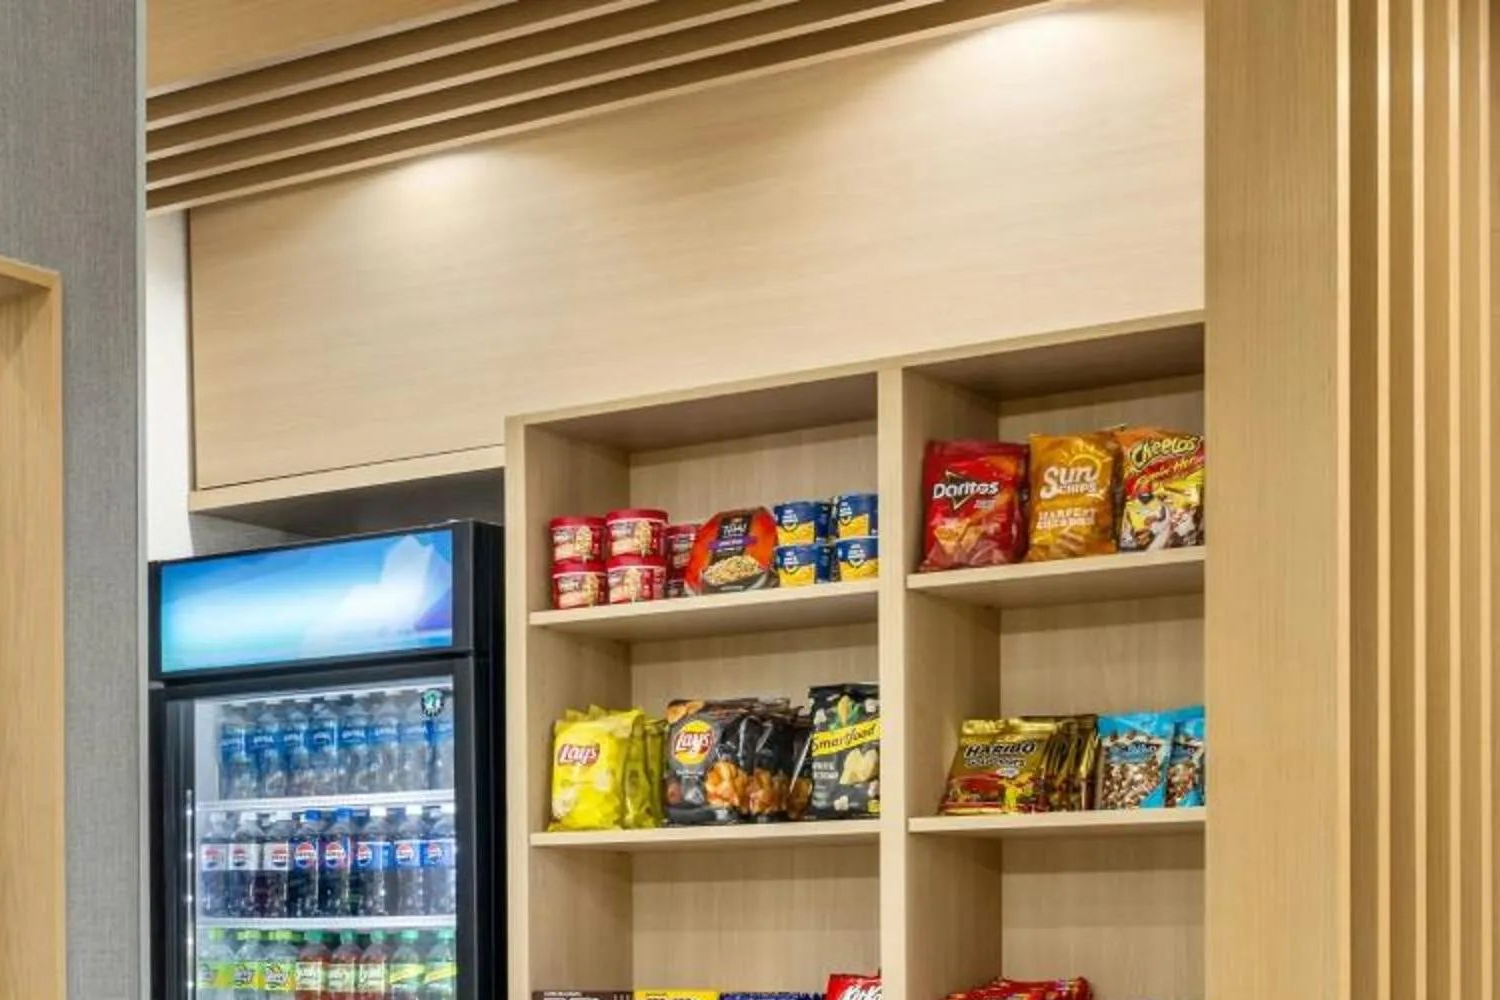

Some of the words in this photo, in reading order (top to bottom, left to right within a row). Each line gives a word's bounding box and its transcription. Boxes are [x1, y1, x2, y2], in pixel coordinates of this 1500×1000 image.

[1130, 436, 1197, 469] Cheetos
[932, 481, 999, 499] Doritos
[811, 722, 878, 751] Smartfood
[559, 744, 598, 766] Lay's
[964, 740, 1036, 757] HARIBO
